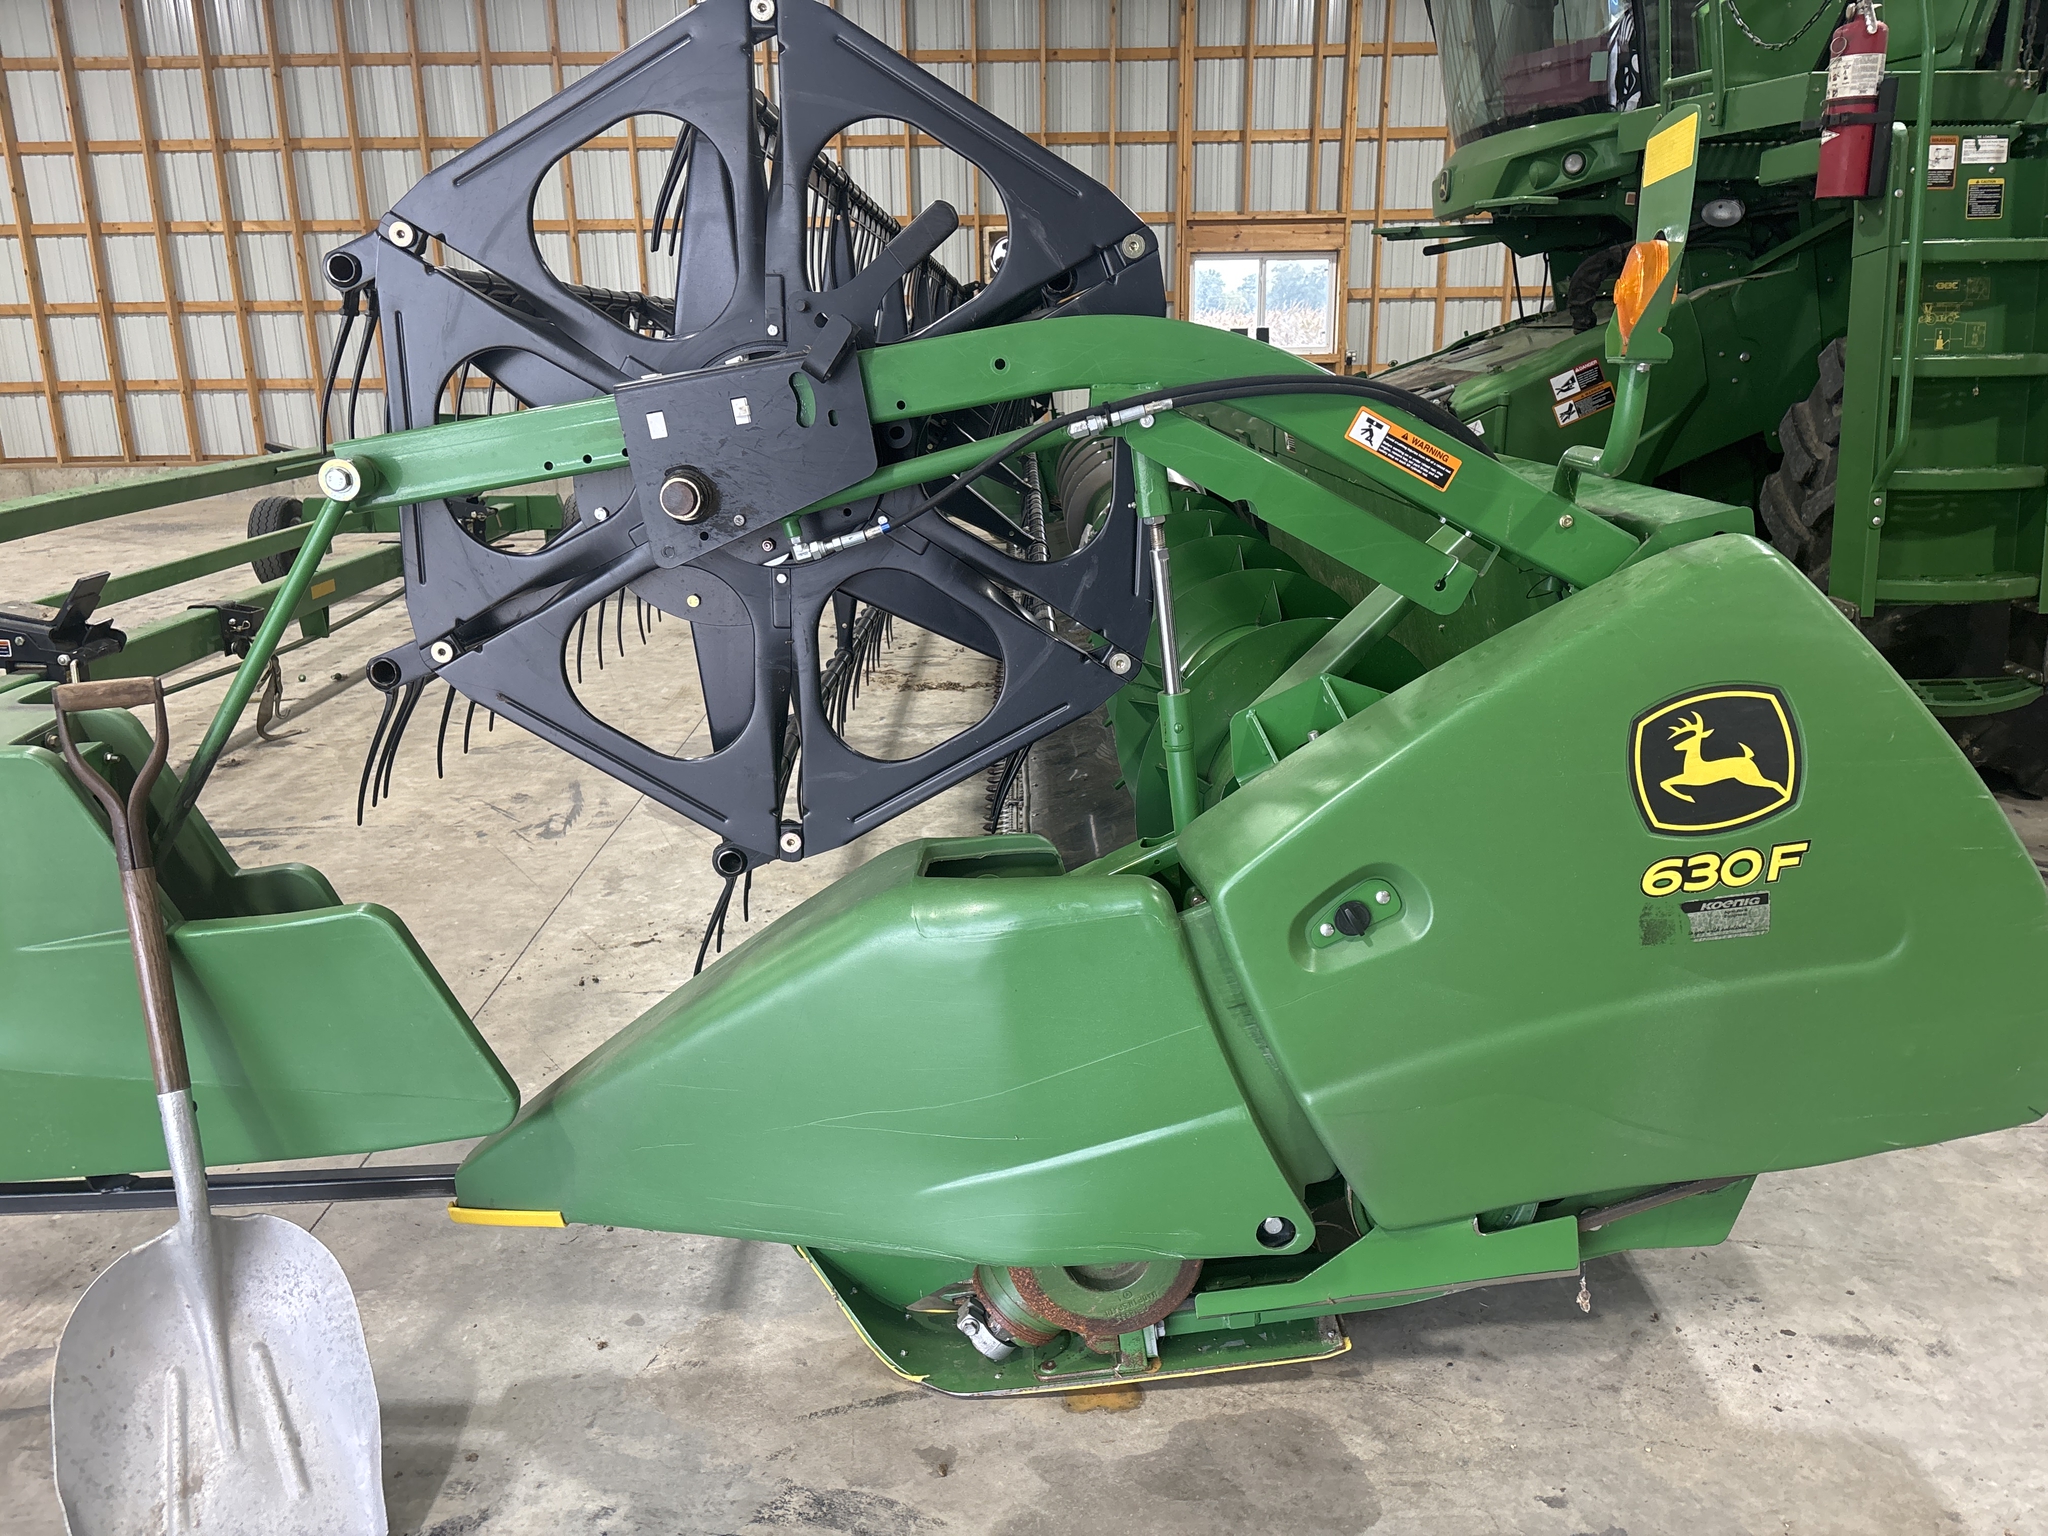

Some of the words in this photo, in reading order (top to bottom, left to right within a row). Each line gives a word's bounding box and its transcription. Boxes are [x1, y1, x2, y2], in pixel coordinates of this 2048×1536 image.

[1579, 359, 1598, 370] DANGER
[1411, 437, 1450, 463] WARNING
[1640, 839, 1811, 899] 630F
